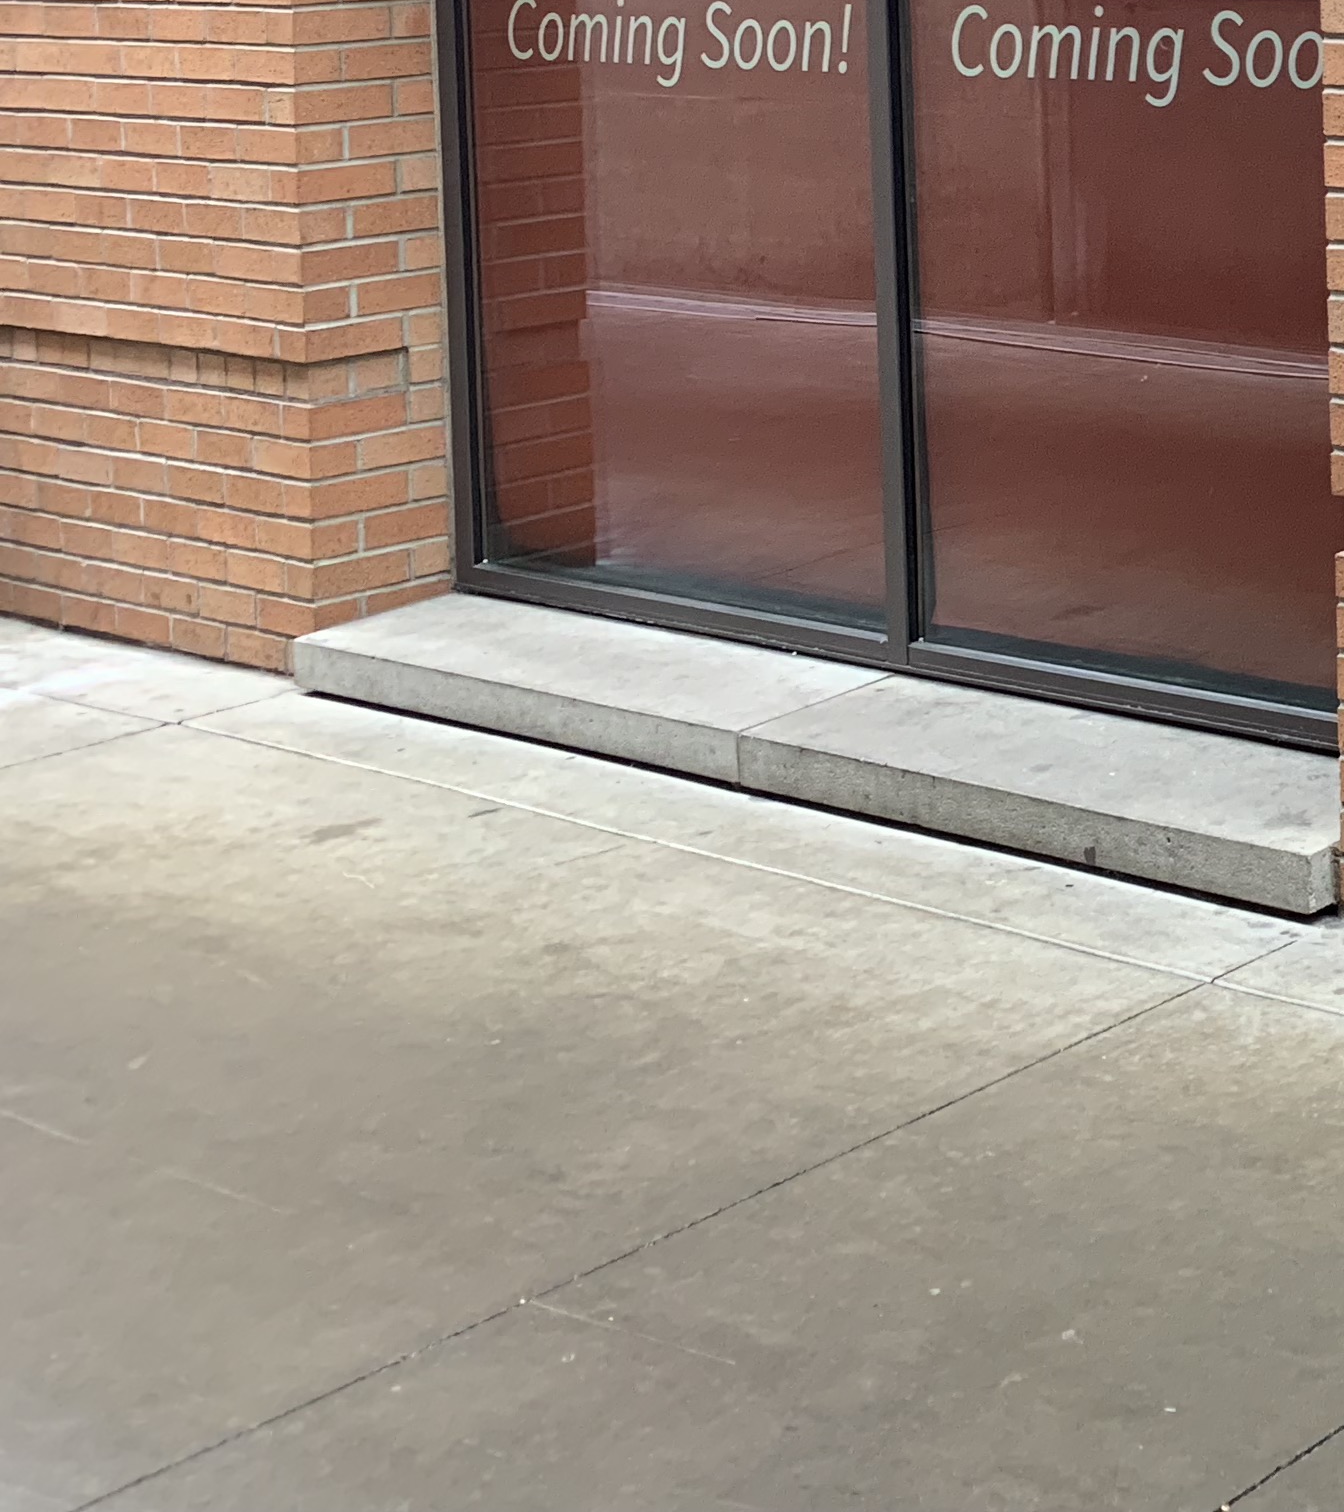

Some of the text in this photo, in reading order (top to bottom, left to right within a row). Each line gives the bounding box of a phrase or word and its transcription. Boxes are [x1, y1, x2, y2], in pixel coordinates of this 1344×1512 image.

[701, 0, 853, 74] Soon!
[951, 3, 1324, 108] Coming Soo
